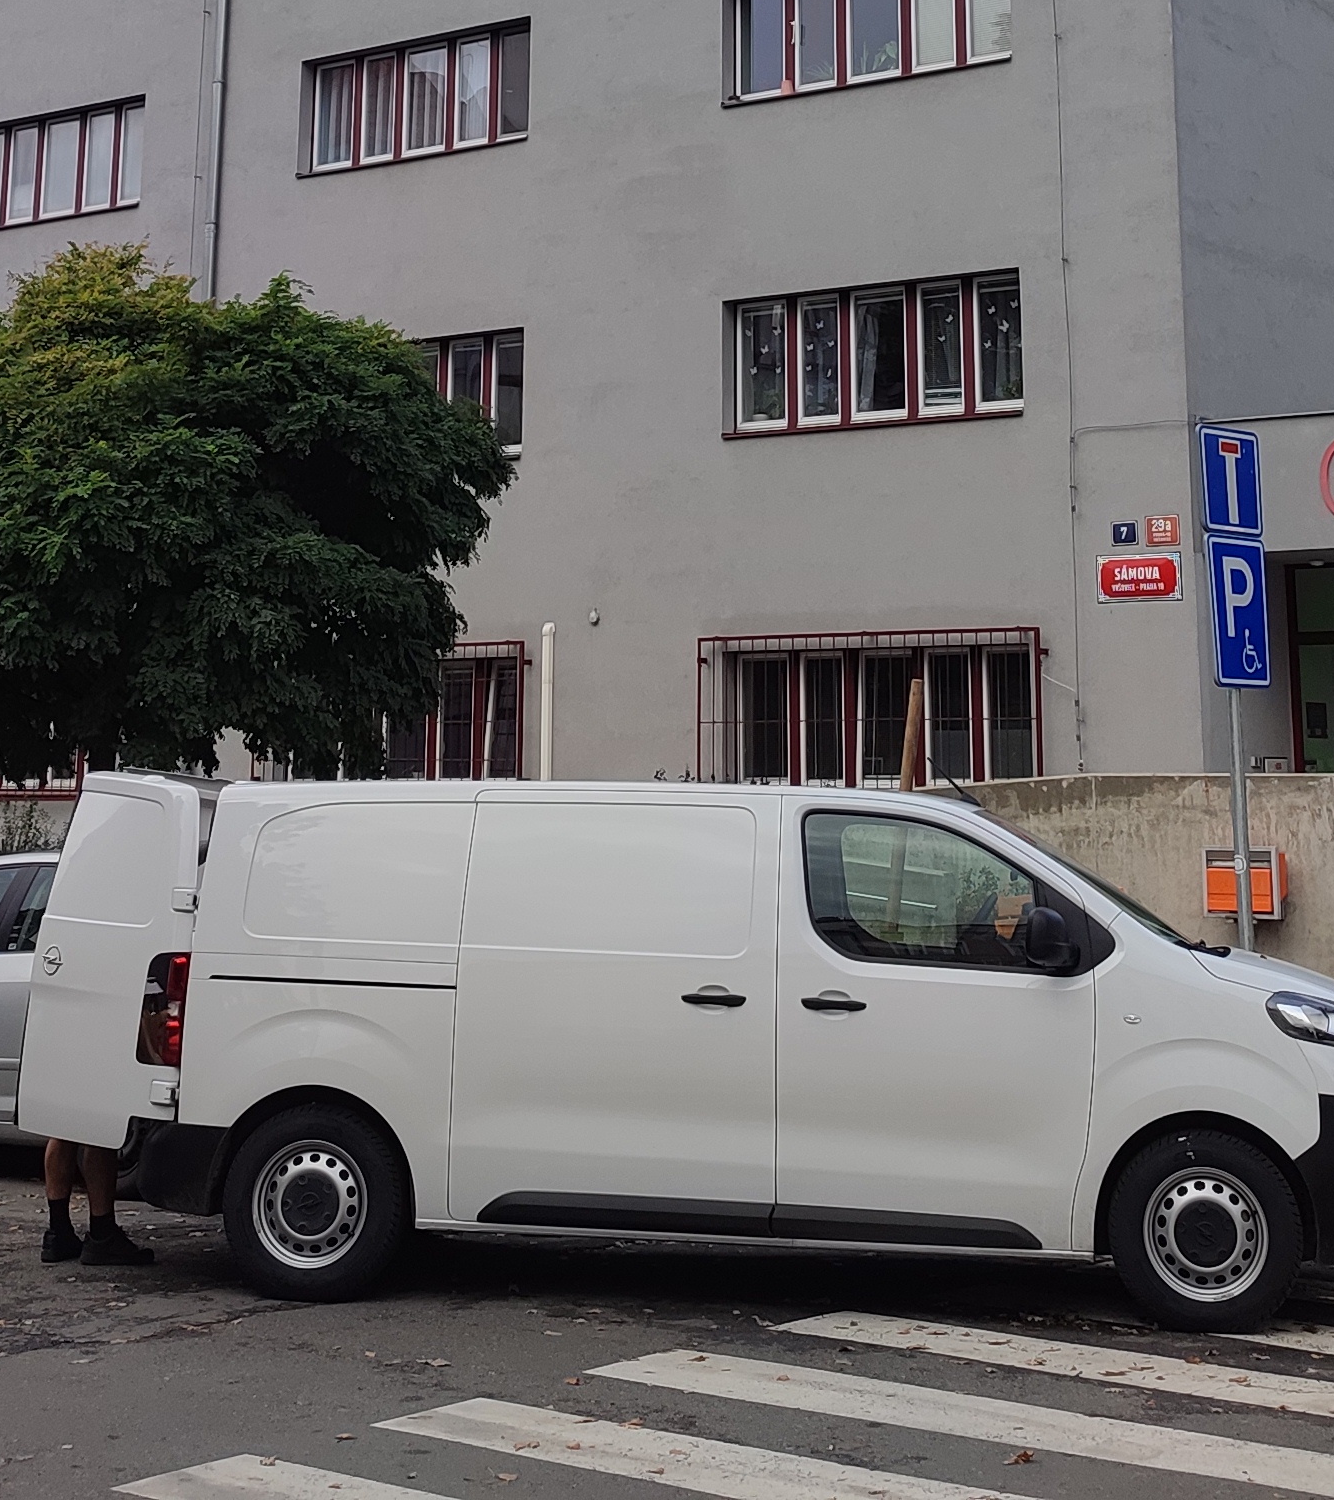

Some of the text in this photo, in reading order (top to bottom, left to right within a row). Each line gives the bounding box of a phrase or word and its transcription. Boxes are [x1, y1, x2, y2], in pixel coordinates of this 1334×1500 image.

[1119, 526, 1128, 540] 7
[1114, 564, 1161, 581] SÁMOVA
[1222, 555, 1255, 638] P
